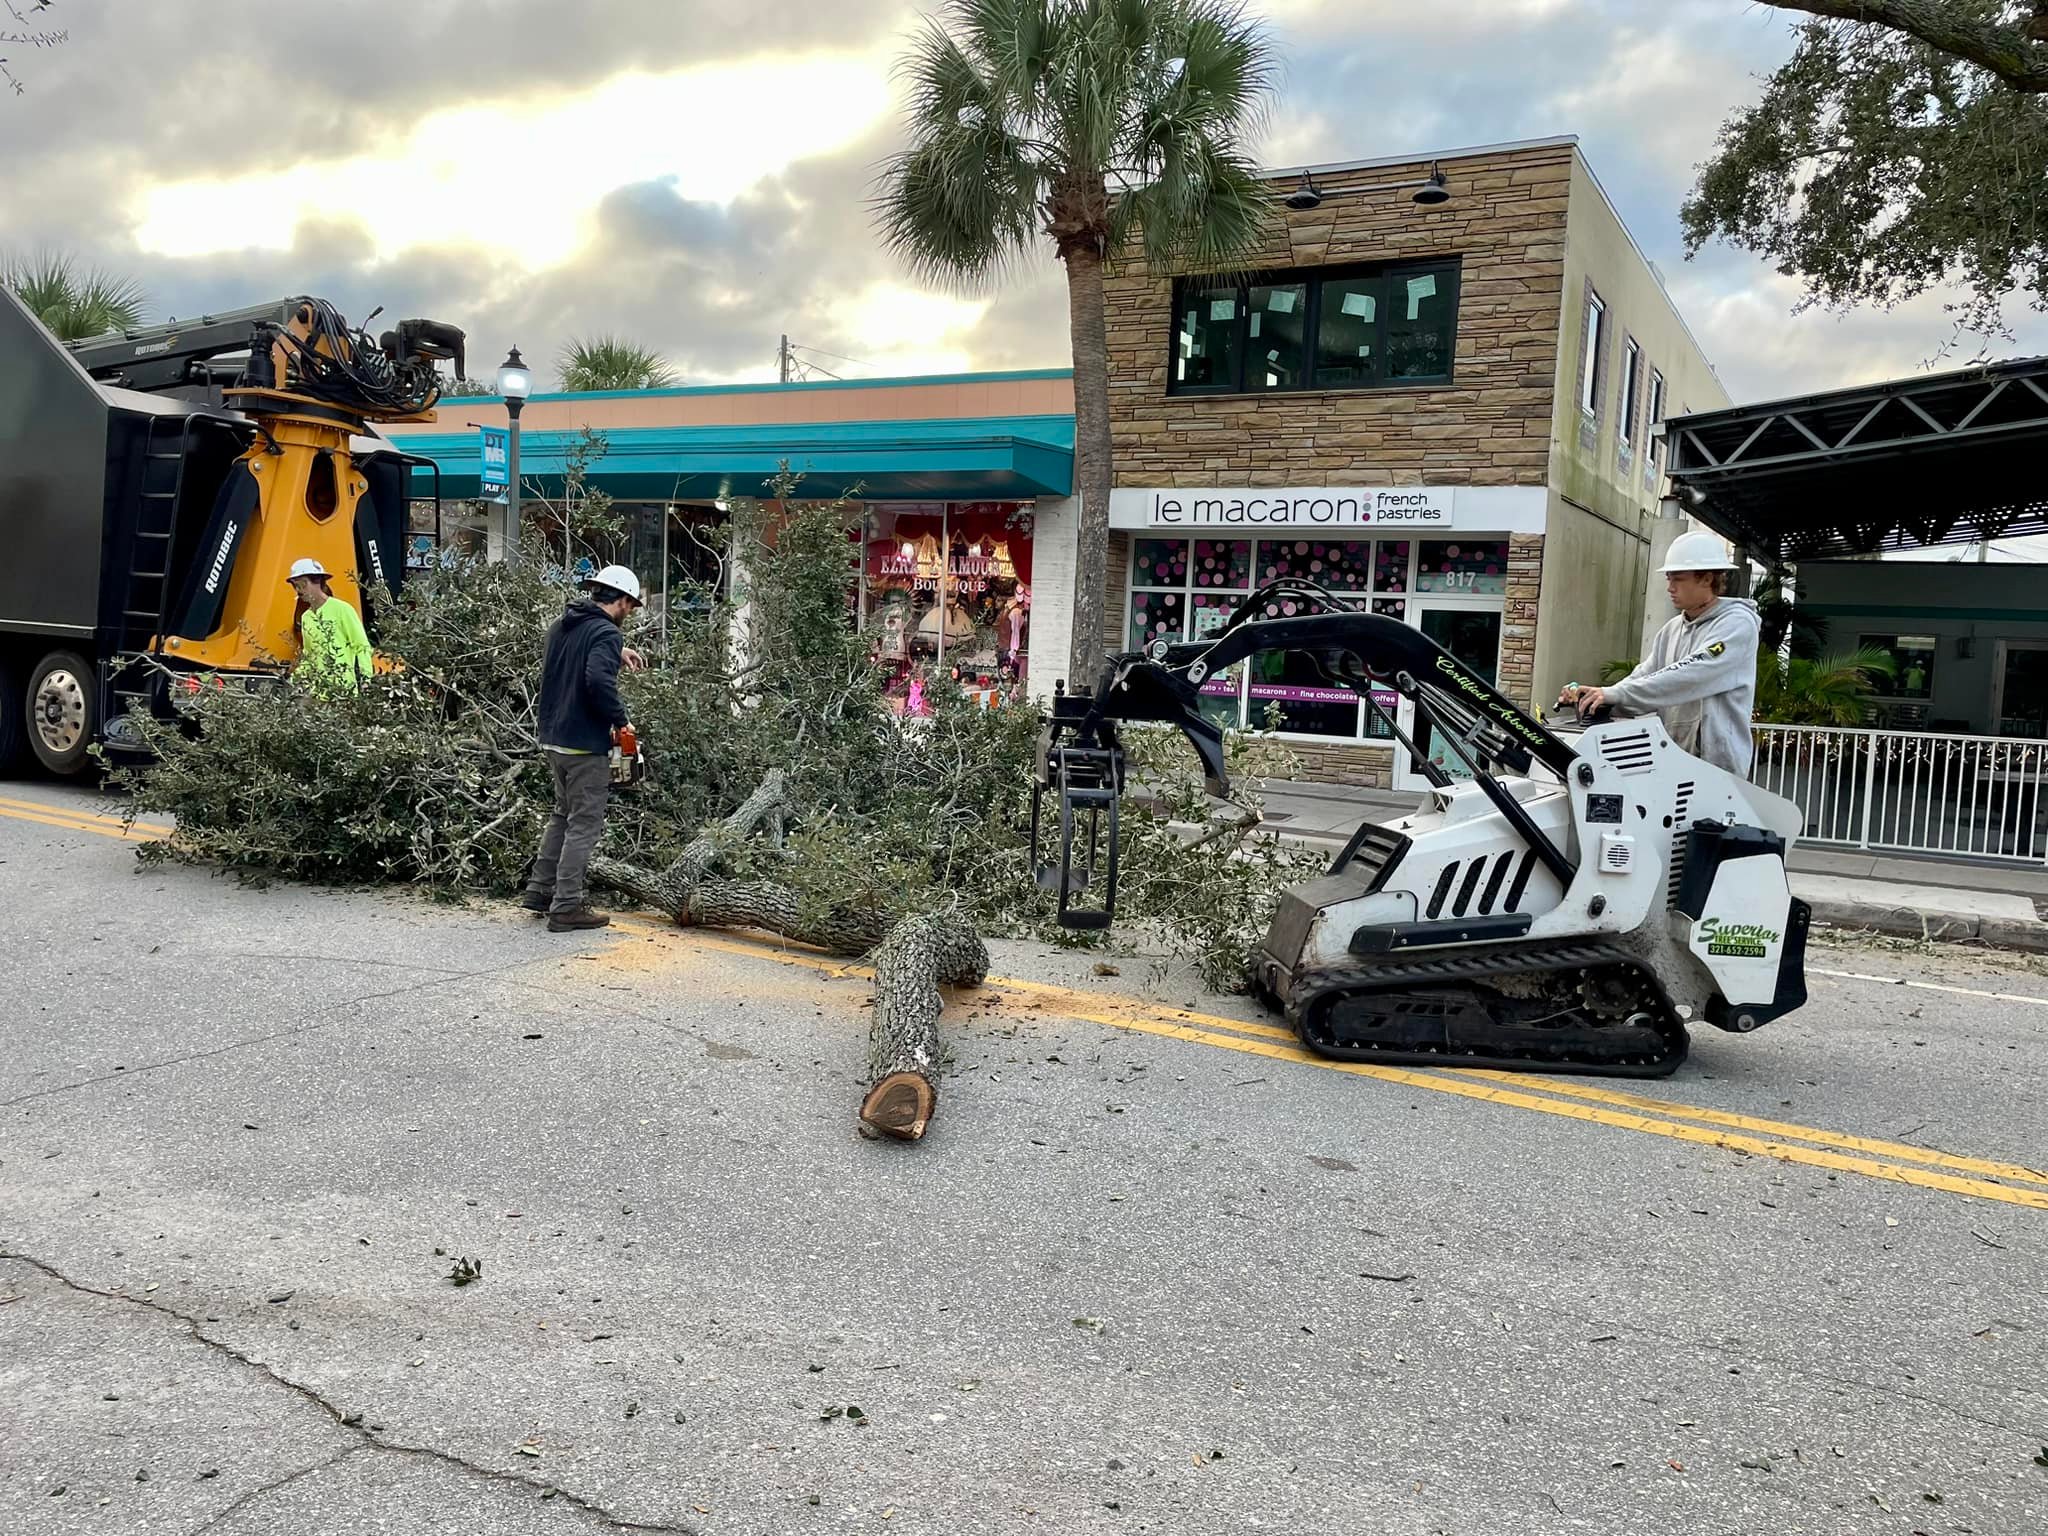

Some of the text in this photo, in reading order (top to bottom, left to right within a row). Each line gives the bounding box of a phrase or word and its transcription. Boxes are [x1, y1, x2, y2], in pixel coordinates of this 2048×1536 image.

[485, 432, 505, 449] DT
[1155, 494, 1357, 522] le macaron
[1377, 493, 1427, 508] french
[1377, 506, 1441, 521] pastries
[368, 539, 384, 579] ELITE
[913, 578, 986, 593] BOUIQUE
[1446, 571, 1476, 587] 817
[1251, 687, 1358, 701] macarons fine chocolates
[1373, 694, 1396, 703] offee
[1435, 655, 1546, 745] Certified Arborist
[1697, 917, 1780, 943] Superior
[1709, 945, 1765, 956] 321-652-2594
